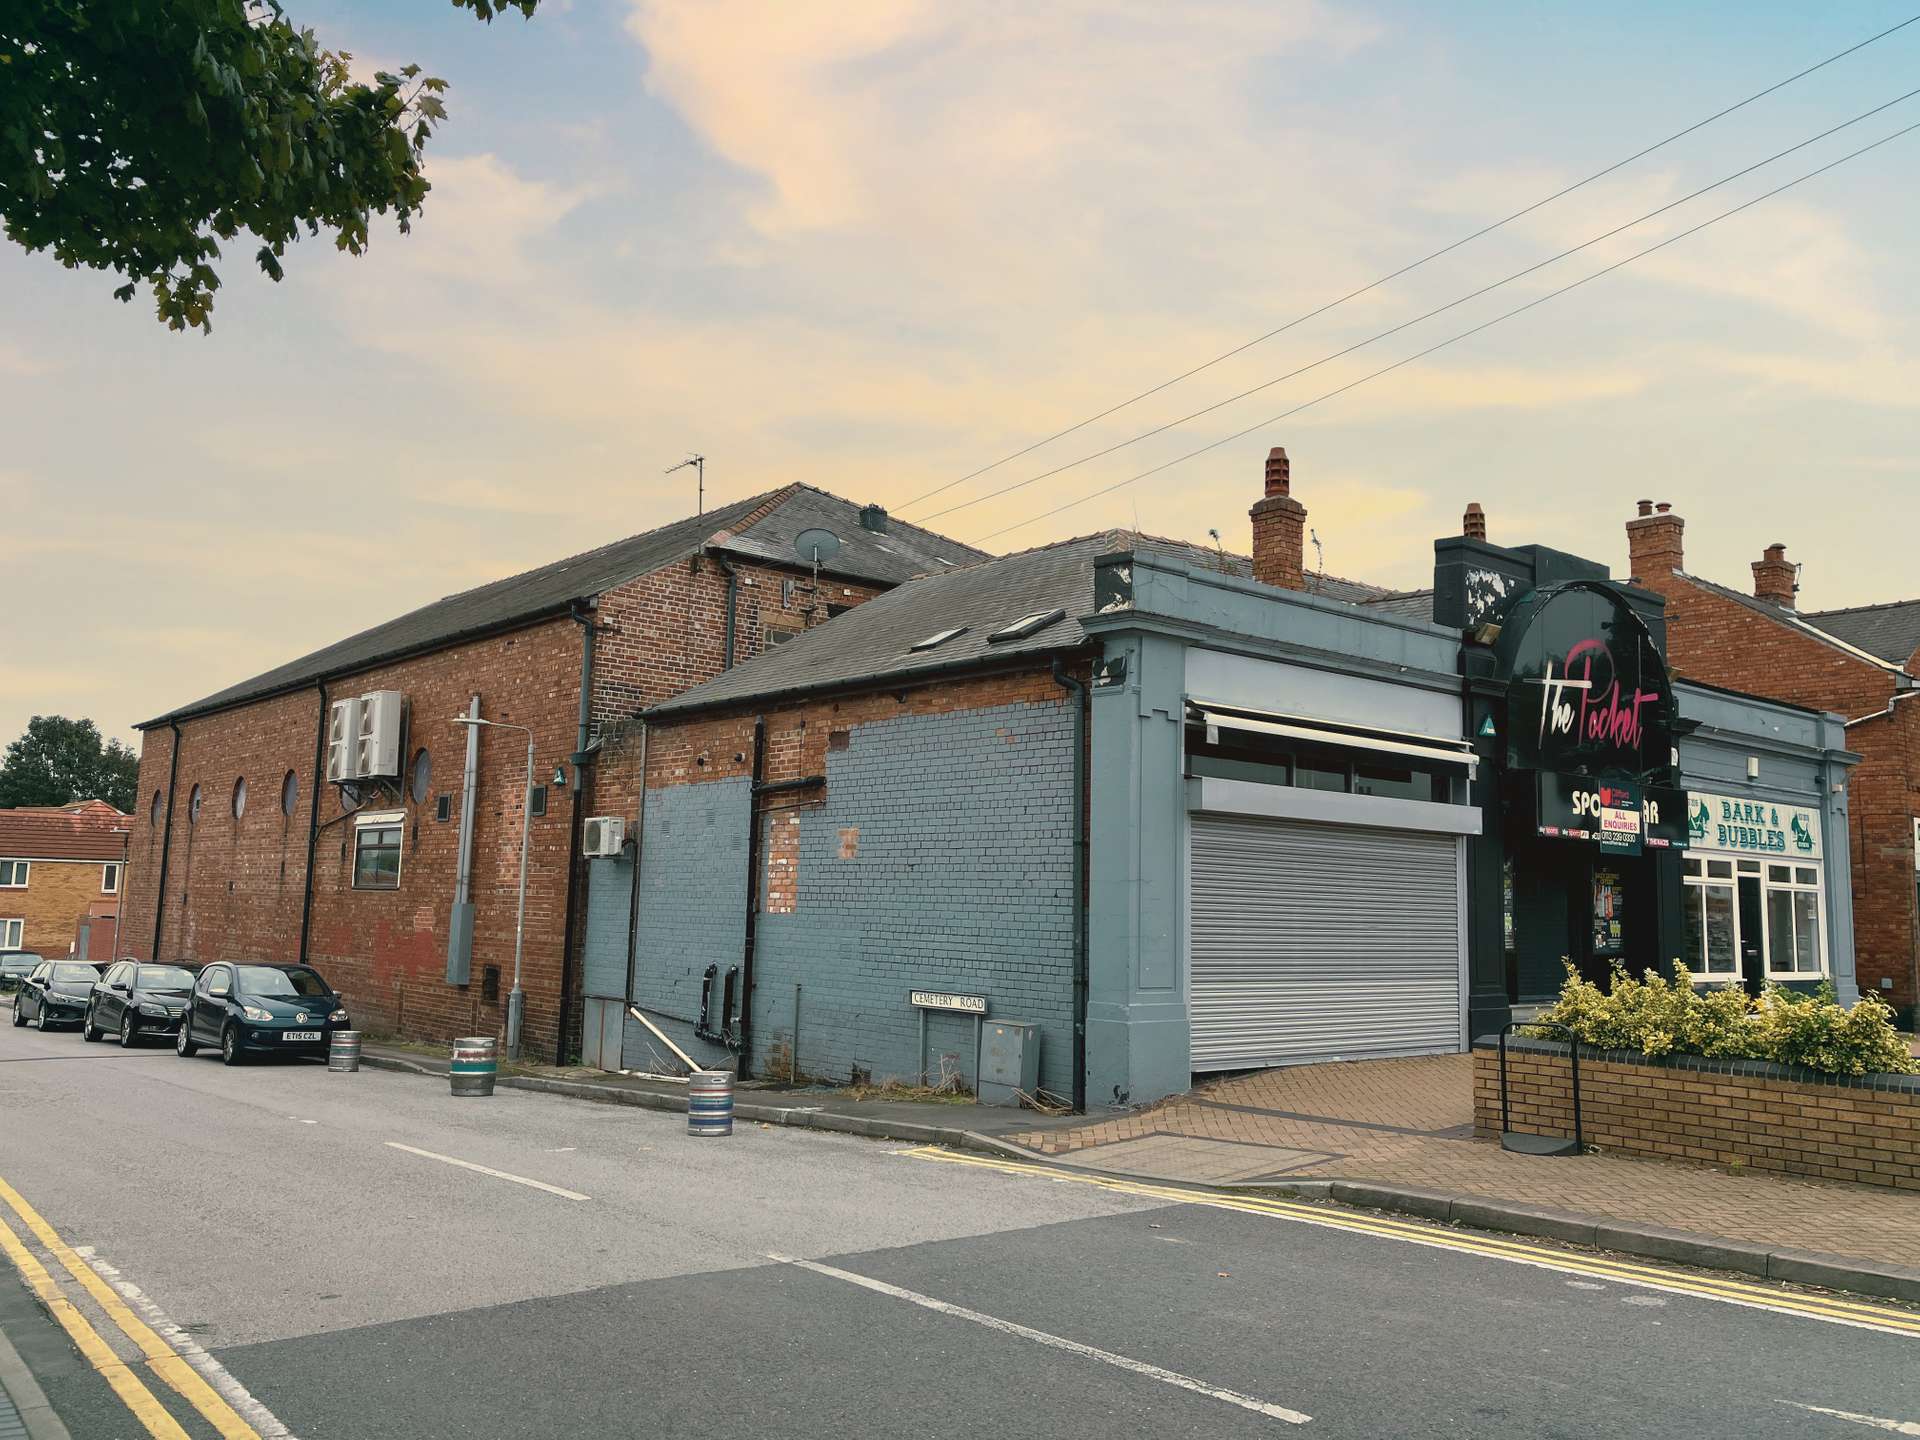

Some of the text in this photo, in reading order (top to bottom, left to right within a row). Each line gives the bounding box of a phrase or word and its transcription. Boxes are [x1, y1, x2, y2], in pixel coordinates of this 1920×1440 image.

[1522, 639, 1659, 750] The Pocket
[1572, 790, 1601, 818] SPO
[1642, 799, 1659, 825] AR
[1615, 811, 1626, 820] ALL
[1721, 801, 1779, 828] BARK &
[1603, 820, 1638, 832] ENQUIRIES
[1717, 824, 1785, 852] BUBBLES
[914, 992, 984, 1009] CEMETERY ROAD
[303, 1032, 317, 1040] CZL
